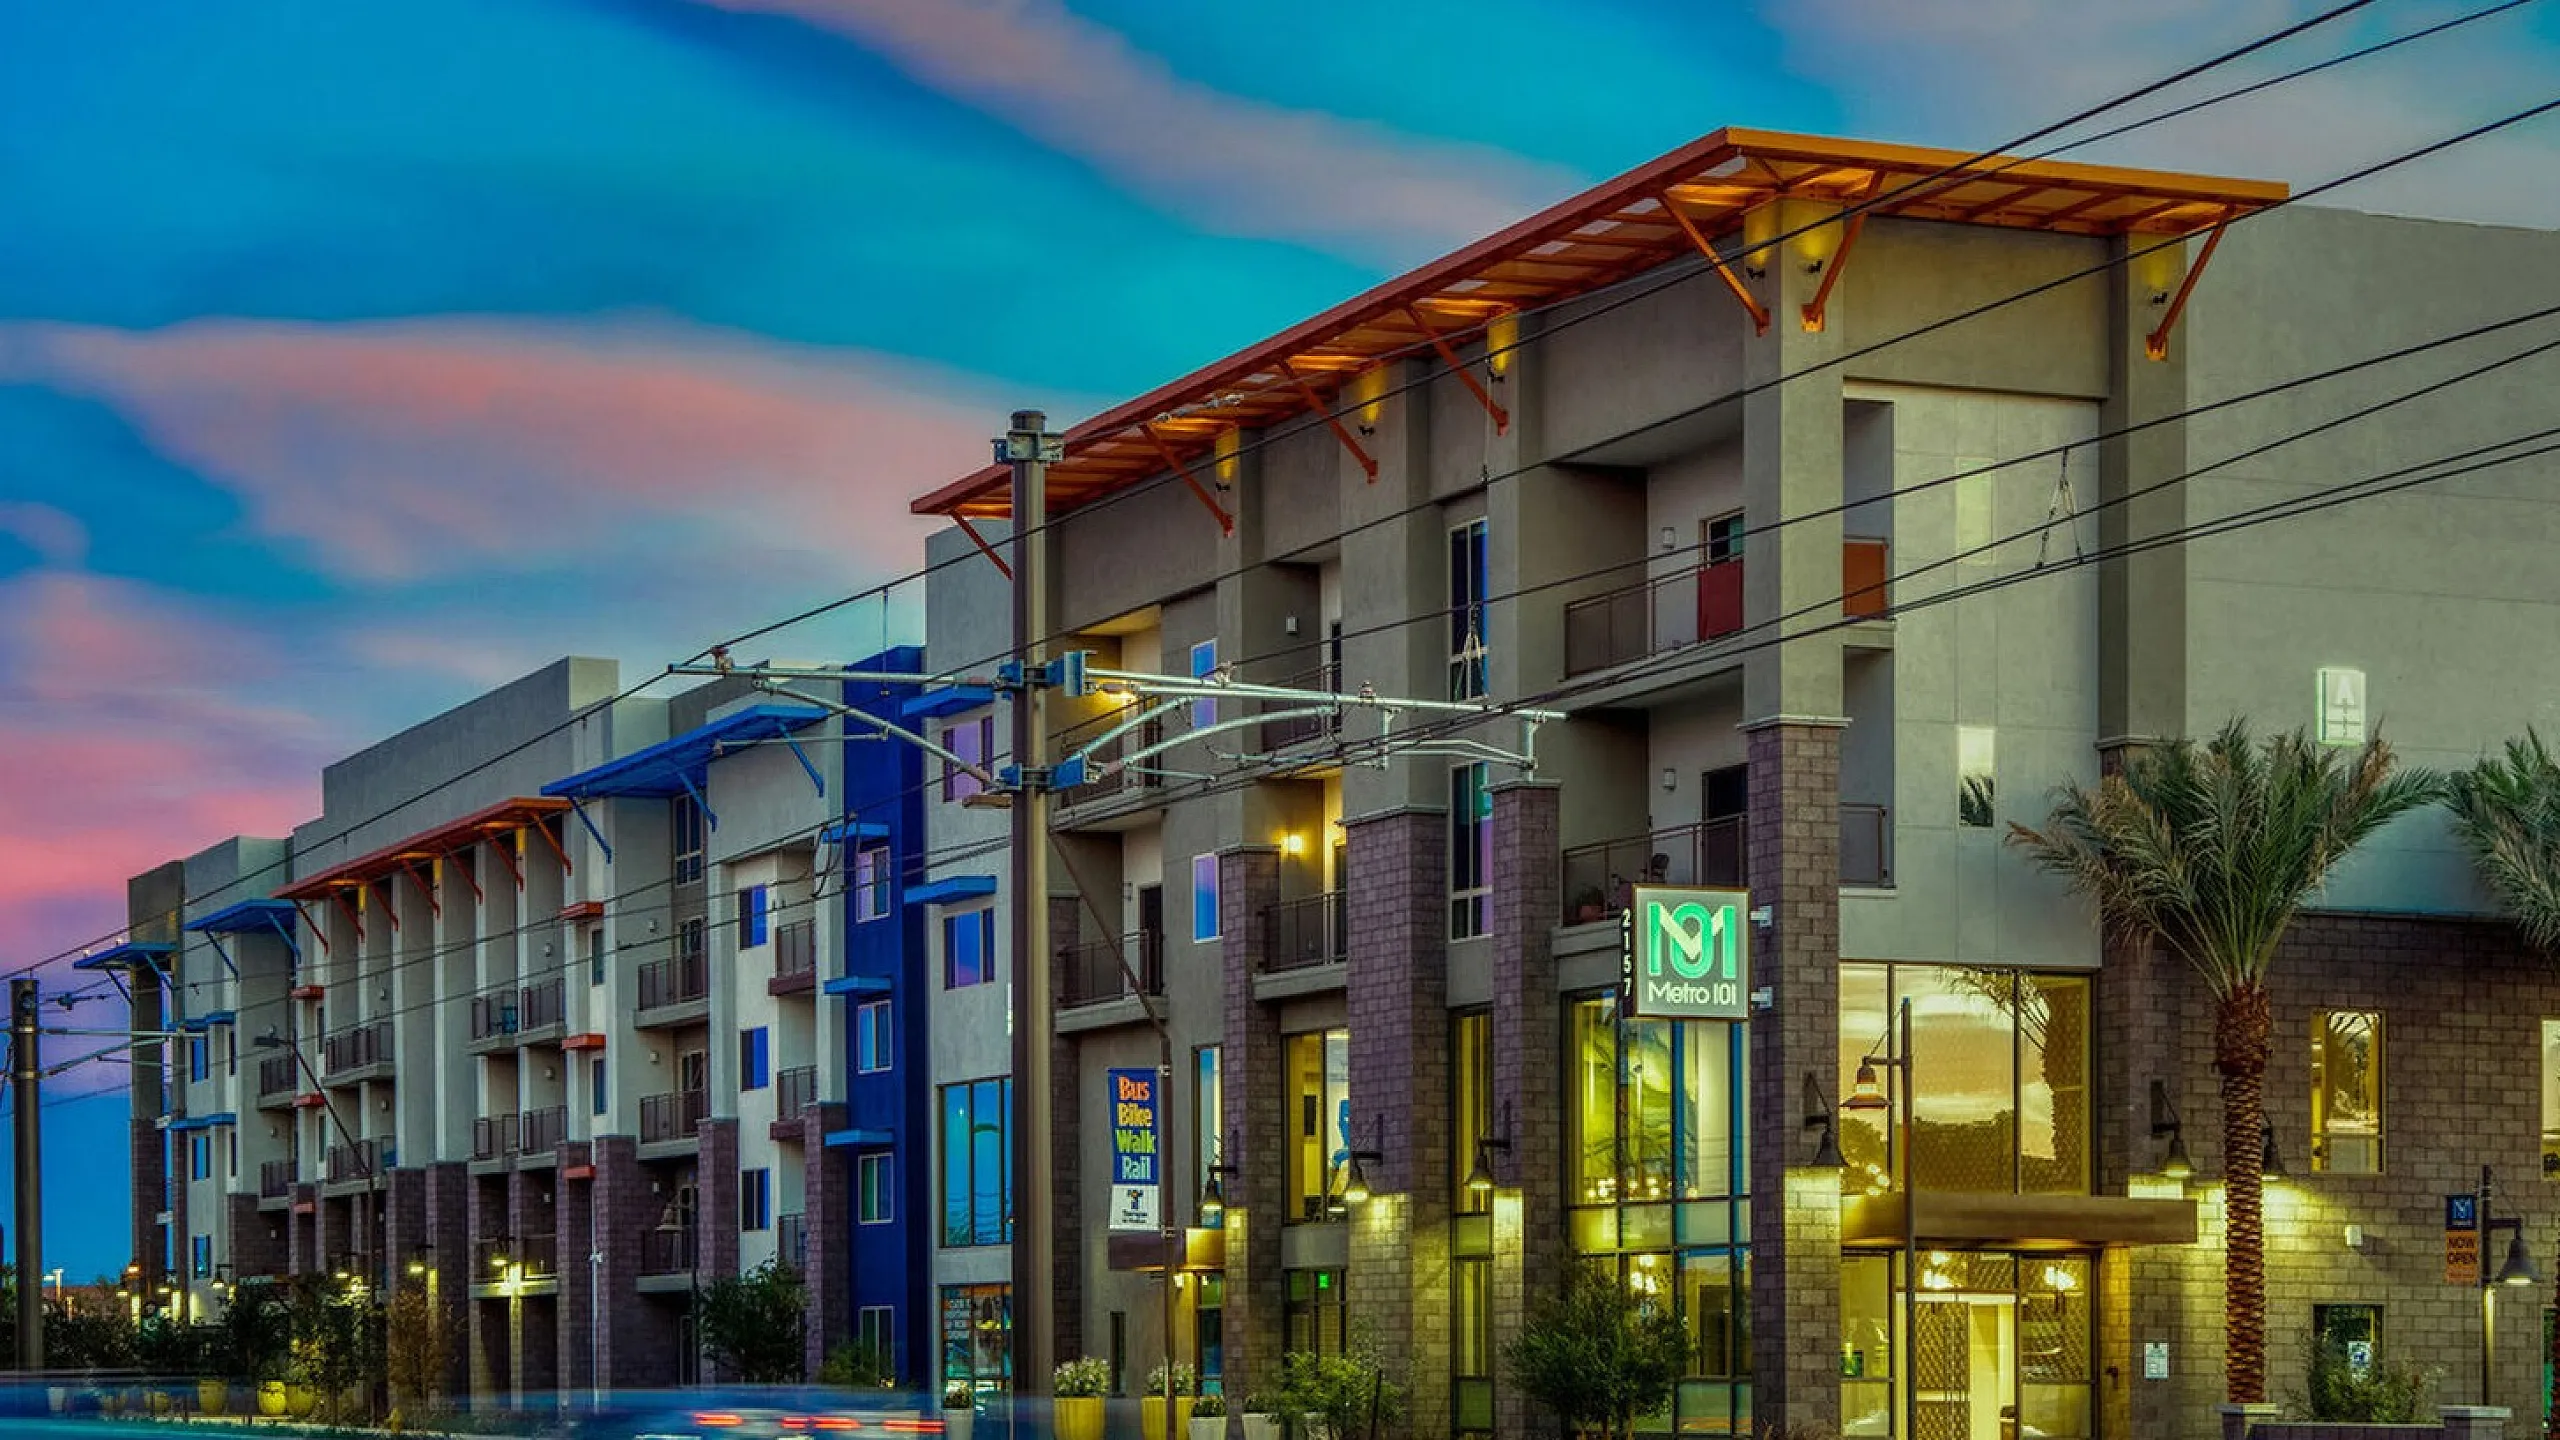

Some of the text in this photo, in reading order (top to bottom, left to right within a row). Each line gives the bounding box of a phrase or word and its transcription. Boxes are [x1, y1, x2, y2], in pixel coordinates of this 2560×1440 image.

[1622, 907, 1632, 997] 2157
[1649, 980, 1737, 1005] Metro 101
[1118, 1076, 1150, 1101] Bus
[1117, 1102, 1153, 1127] Bike
[1115, 1129, 1156, 1154] Walk
[1121, 1156, 1151, 1180] Rail
[2448, 1238, 2475, 1249] NOW
[2447, 1252, 2478, 1265] OPEN
